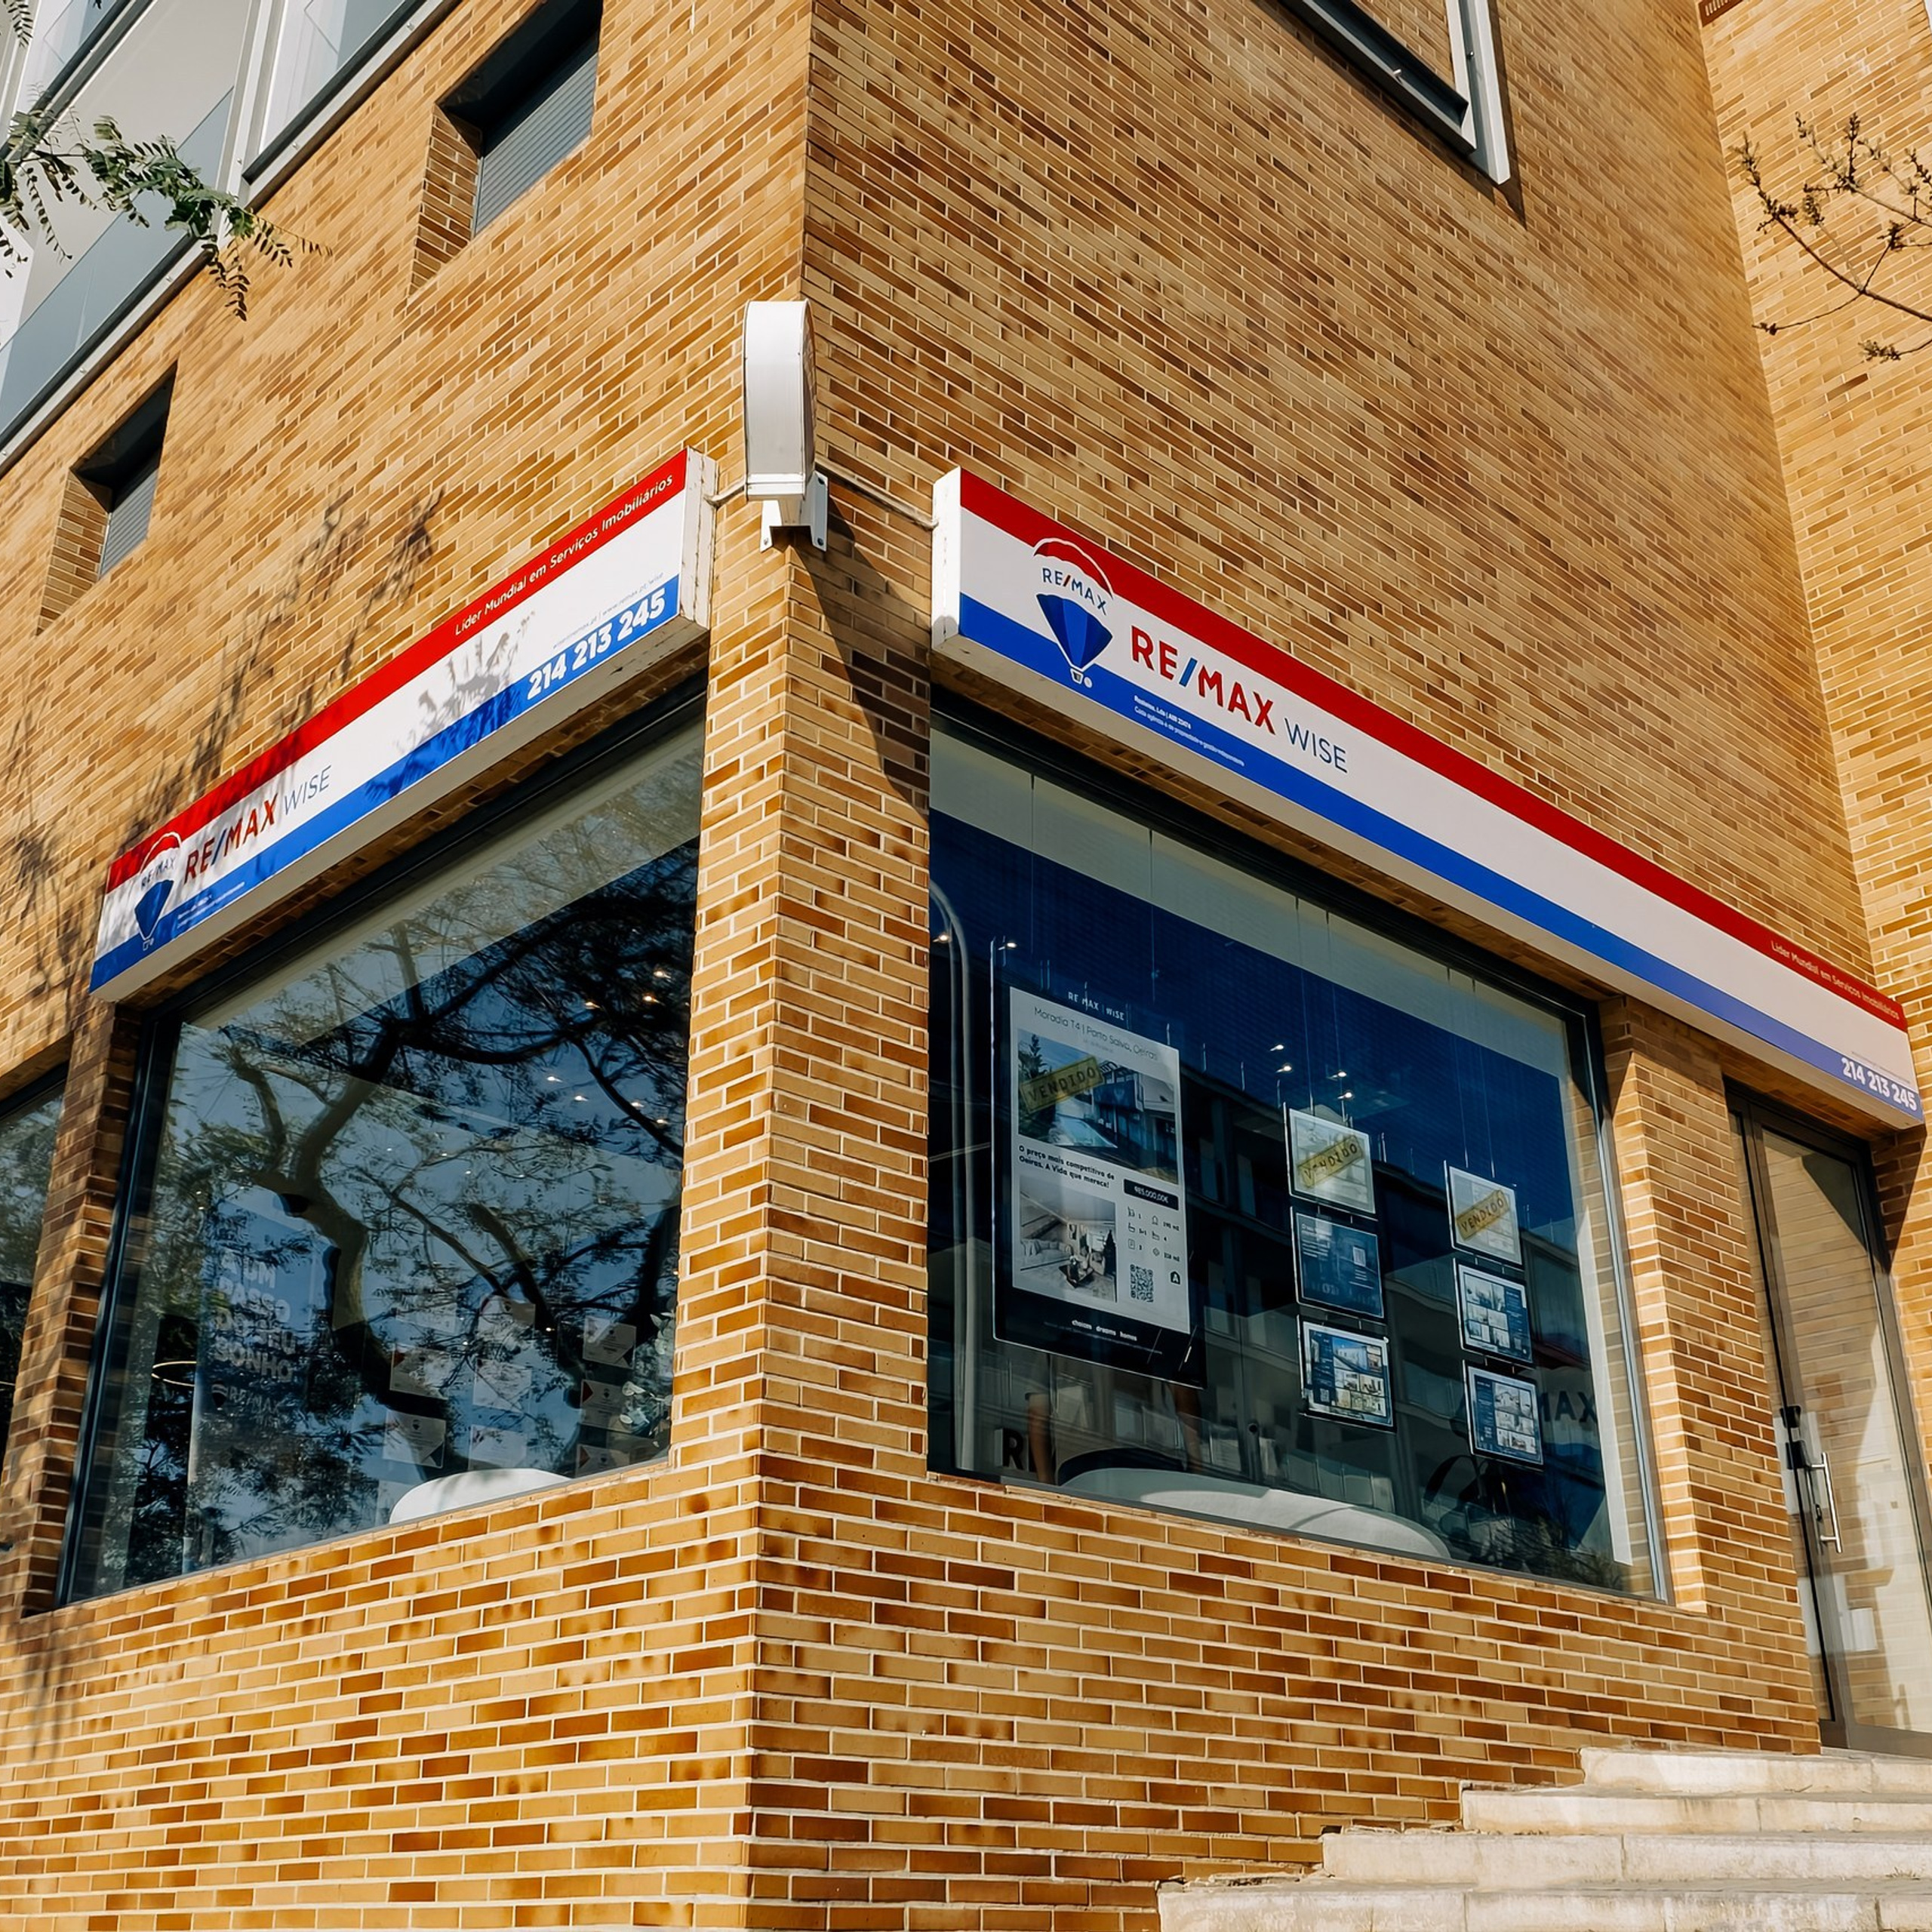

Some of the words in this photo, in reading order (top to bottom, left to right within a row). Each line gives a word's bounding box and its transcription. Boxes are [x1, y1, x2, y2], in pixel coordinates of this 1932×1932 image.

[485, 581, 527, 615] Mundial
[529, 565, 547, 583] em
[549, 527, 598, 568] Serviços
[601, 475, 672, 532] Imobiliários
[1041, 567, 1107, 617] RE/MAX
[528, 654, 568, 700] 214
[572, 623, 612, 672] 213
[617, 587, 666, 641] 245
[1131, 625, 1276, 735] RE/MAX
[1284, 717, 1348, 774] WISE
[183, 792, 278, 884] RE/MAX
[284, 764, 331, 816] WISE
[1820, 970, 1832, 982] em
[1035, 1006, 1069, 1026] Moradia
[1028, 1066, 1097, 1103] VENDIDO
[1841, 1057, 1866, 1084] 214
[1867, 1070, 1890, 1098] 213
[1891, 1083, 1918, 1112] 245
[1048, 1155, 1064, 1164] mais
[1069, 1171, 1081, 1180] que
[1461, 1198, 1504, 1232] VENDIDO
[219, 1276, 291, 1322] PASSO
[214, 1335, 293, 1383] SONHO
